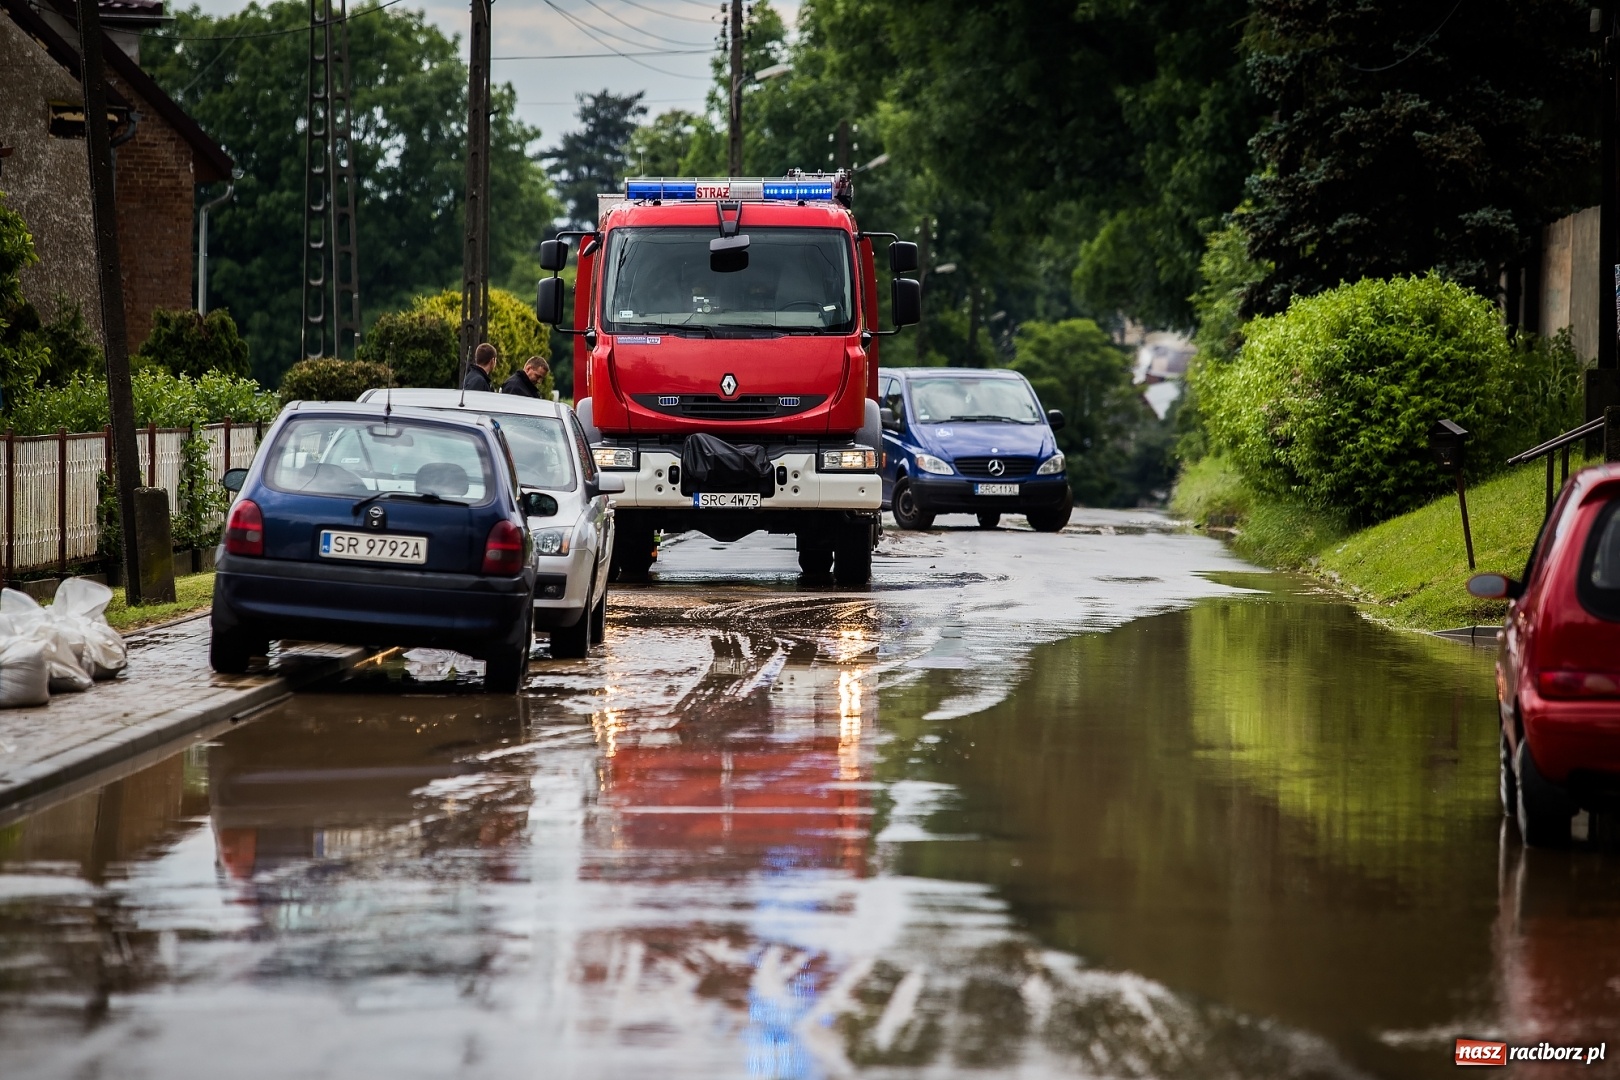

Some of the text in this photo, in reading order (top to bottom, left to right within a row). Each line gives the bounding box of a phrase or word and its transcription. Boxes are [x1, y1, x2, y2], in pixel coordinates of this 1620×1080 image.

[701, 494, 759, 506] SRC 4W75
[333, 536, 421, 559] SR 9792A
